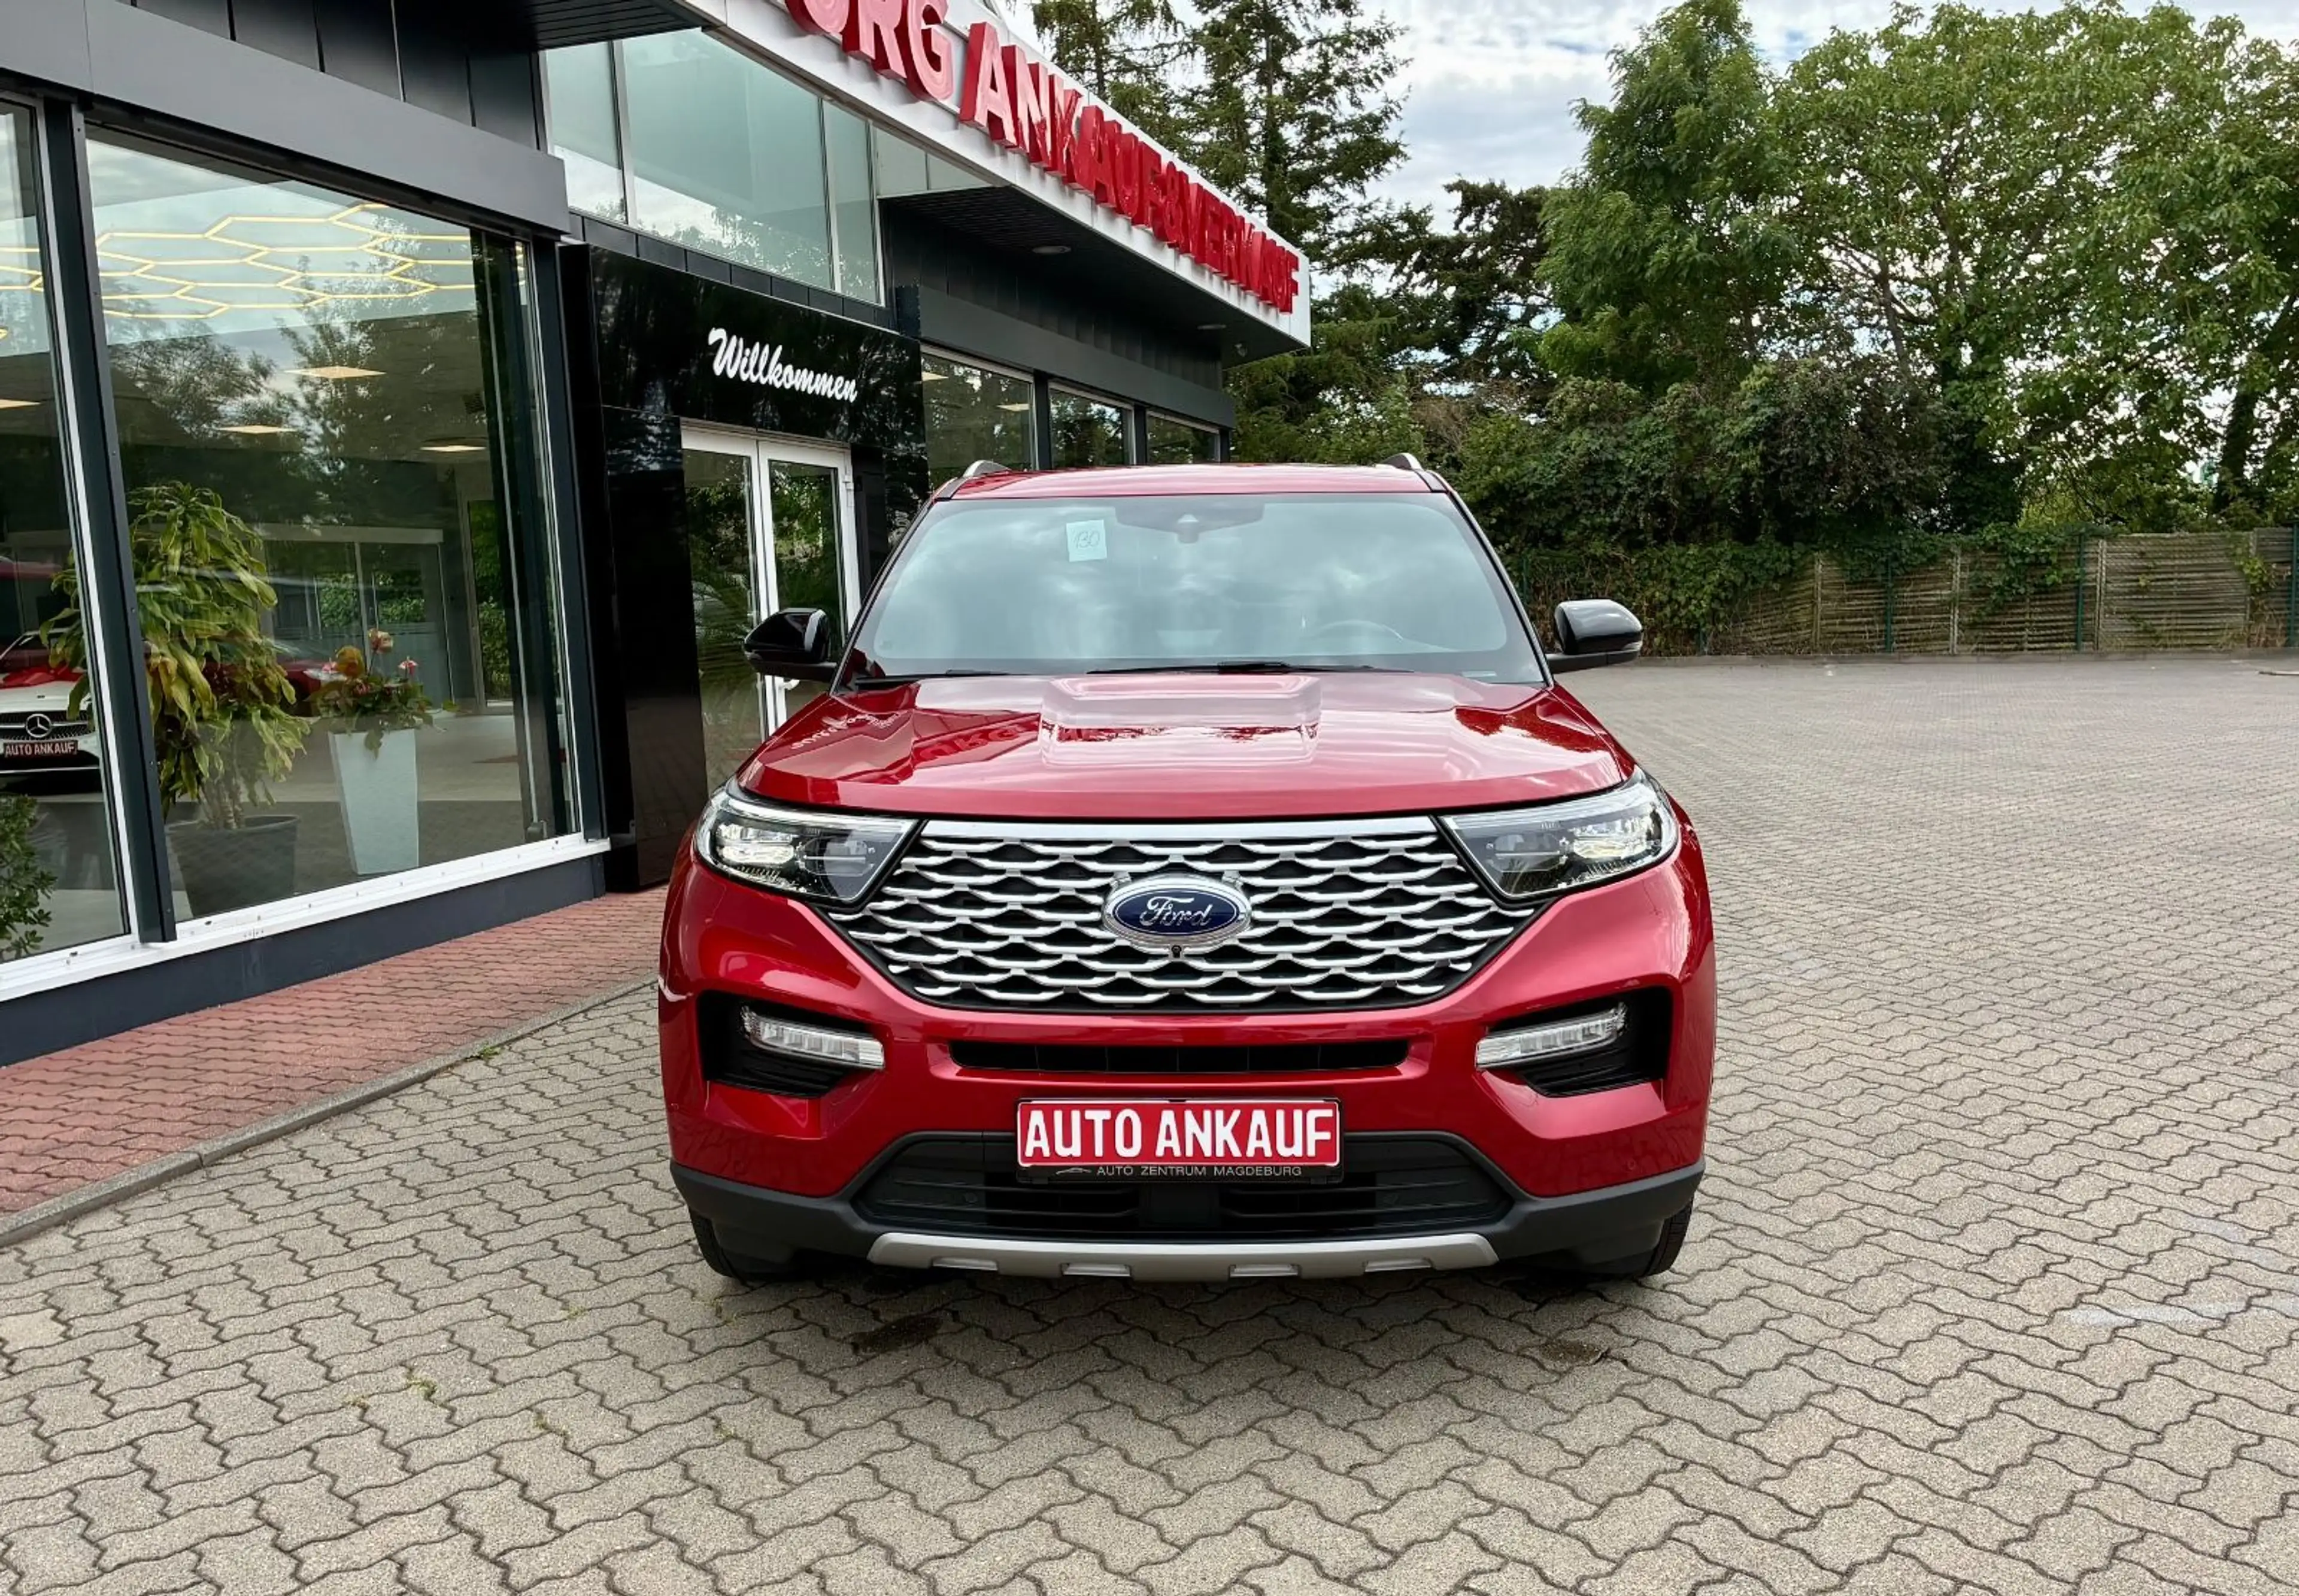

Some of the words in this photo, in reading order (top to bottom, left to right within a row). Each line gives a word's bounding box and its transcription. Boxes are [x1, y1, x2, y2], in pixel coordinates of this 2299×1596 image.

[959, 21, 1161, 230] ANKAUF
[708, 327, 859, 403] Willkommen
[5, 743, 31, 757] AUTO
[34, 742, 75, 755] ANKAUF
[1139, 896, 1214, 927] Ford
[1024, 1109, 1142, 1158] AUTO
[1155, 1109, 1334, 1158] ANKAUF
[1096, 1166, 1133, 1176] AUTO
[1141, 1166, 1206, 1176] ZENTRUM
[1214, 1166, 1302, 1176] MAGDEBURG
